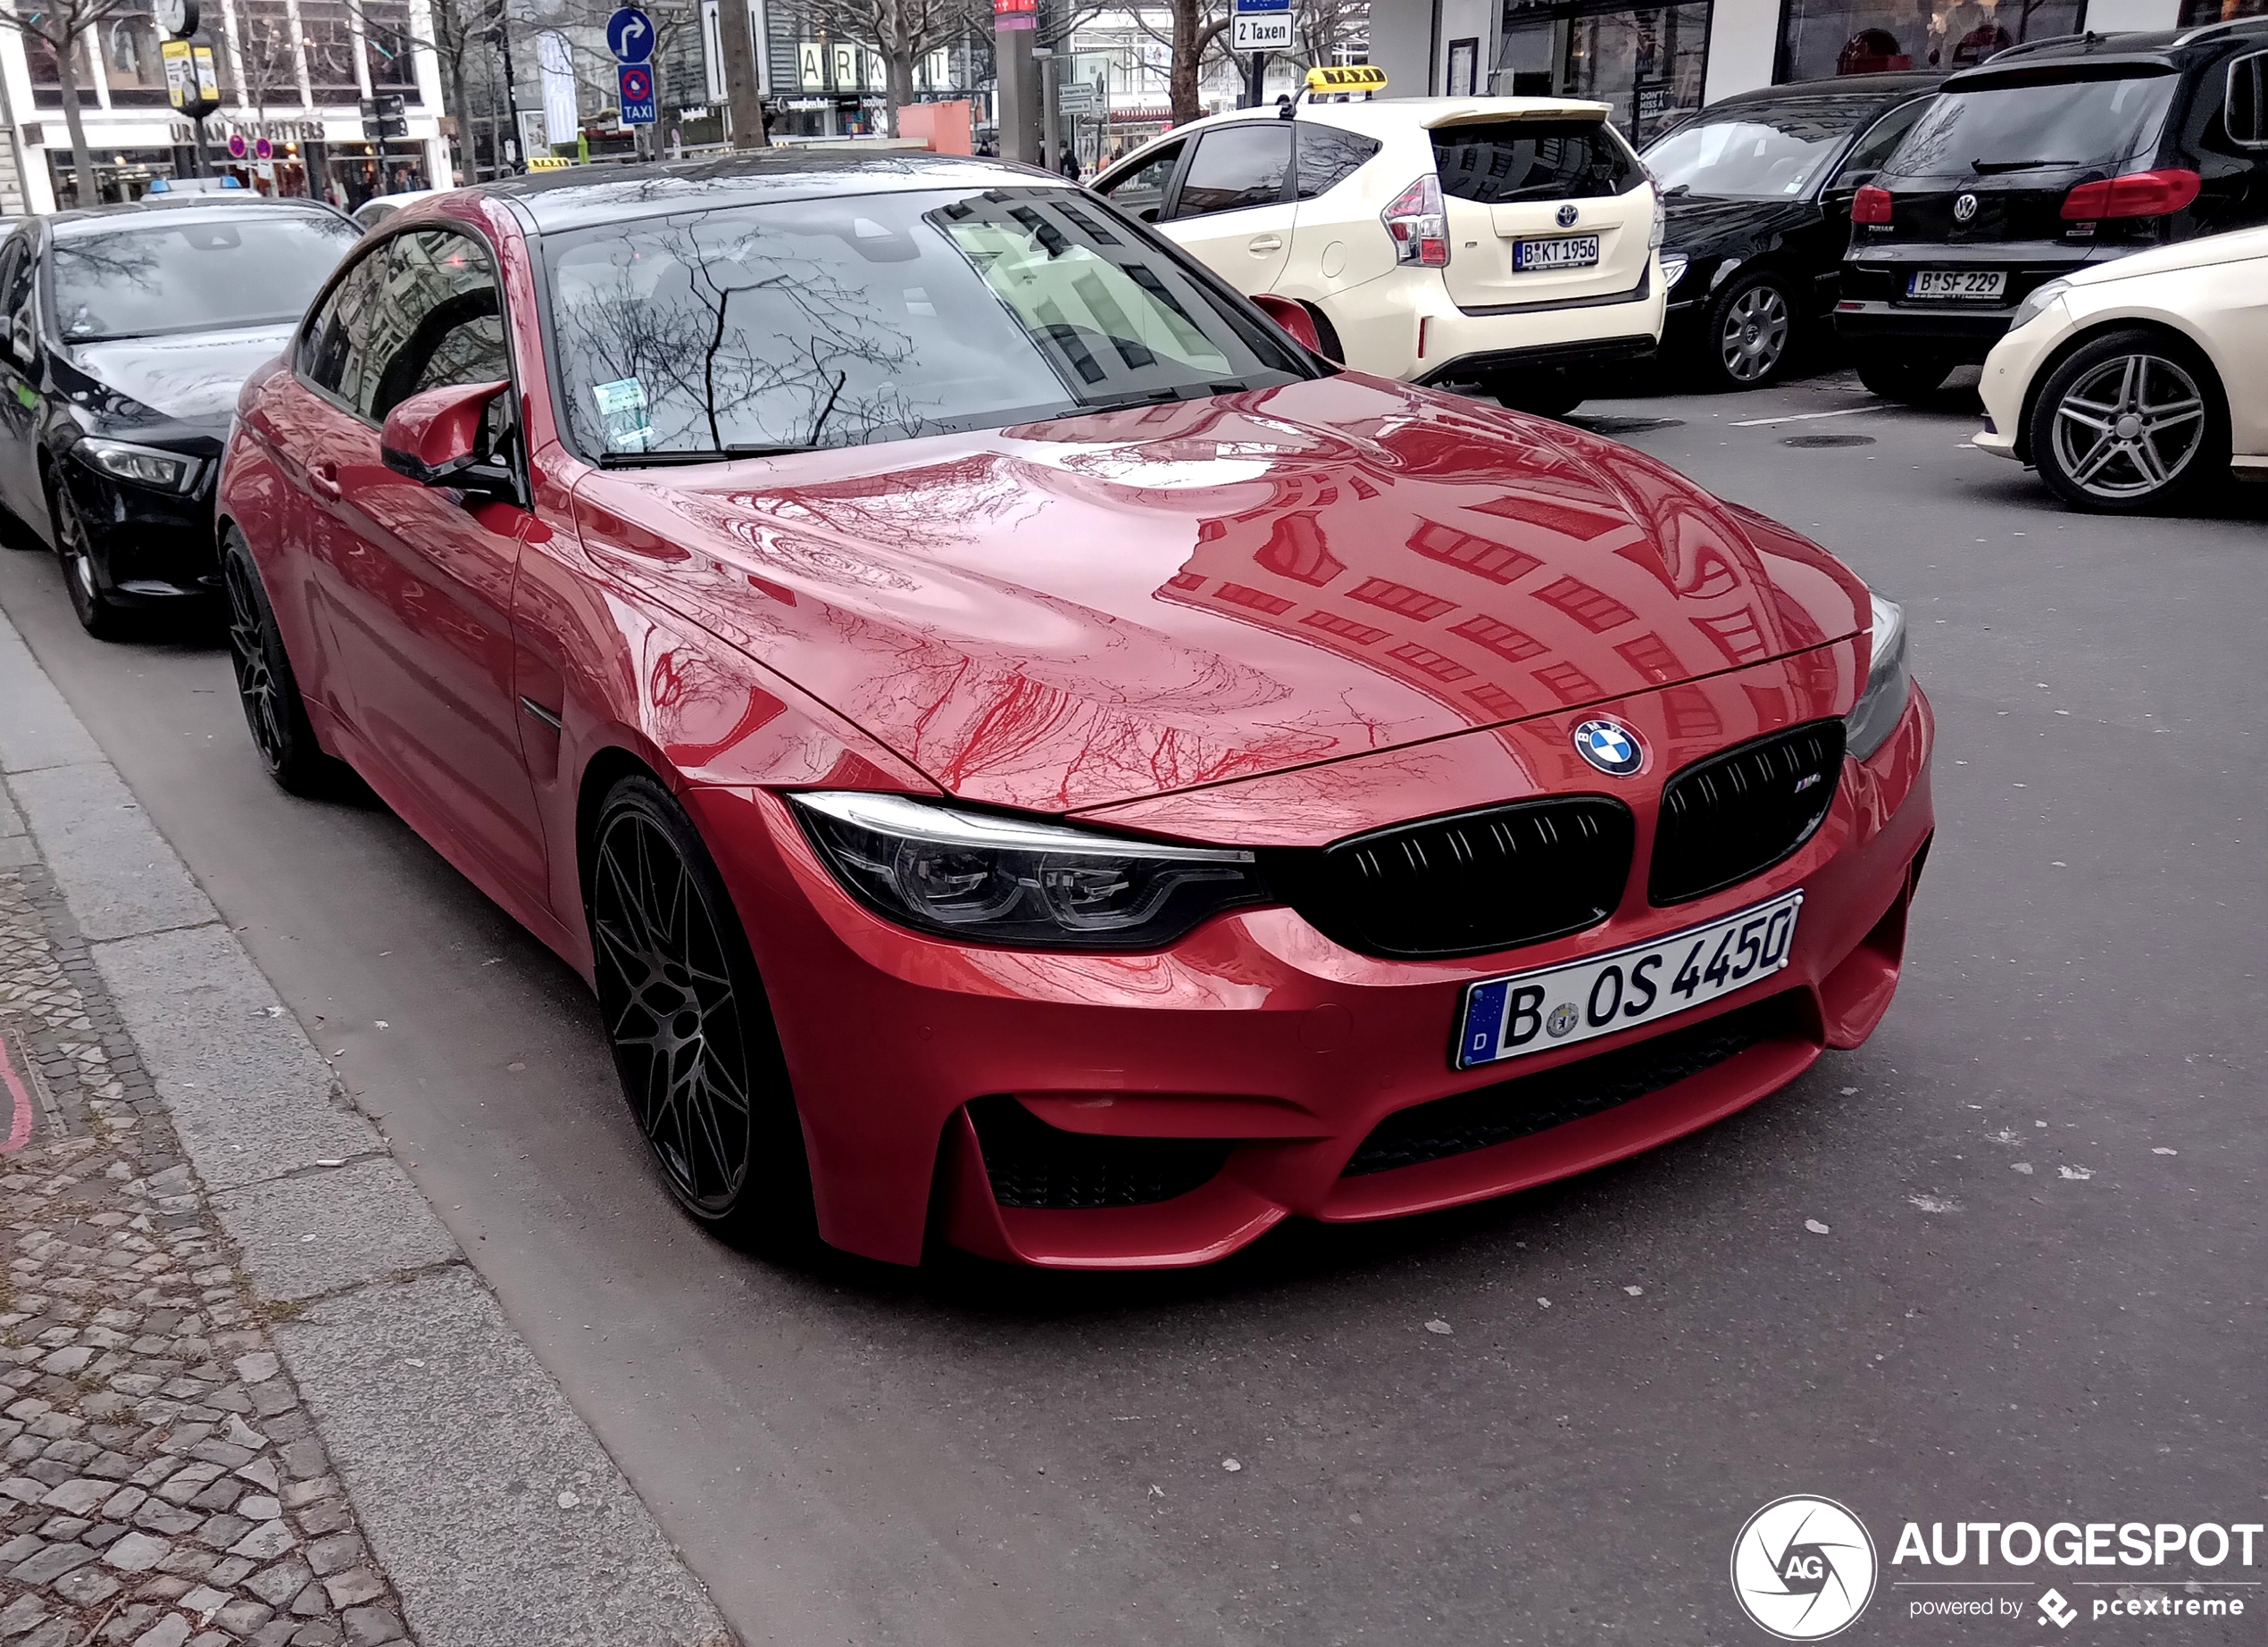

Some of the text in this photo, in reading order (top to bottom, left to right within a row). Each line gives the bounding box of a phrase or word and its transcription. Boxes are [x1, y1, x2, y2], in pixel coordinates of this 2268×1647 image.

[1239, 22, 1286, 41] 2 Taxen
[803, 49, 945, 80] ARKT
[1328, 69, 1378, 83] TAXI
[1639, 90, 1665, 101] DON'T
[1639, 99, 1658, 109] MISS
[1658, 98, 1664, 108] A
[623, 104, 654, 119] TAXI
[1524, 238, 1597, 263] B KT 1956
[1921, 272, 2000, 292] B SF 229
[1577, 721, 1622, 743] BMW
[1503, 905, 1793, 1049] B OS 4450
[1473, 1032, 1487, 1051] D
